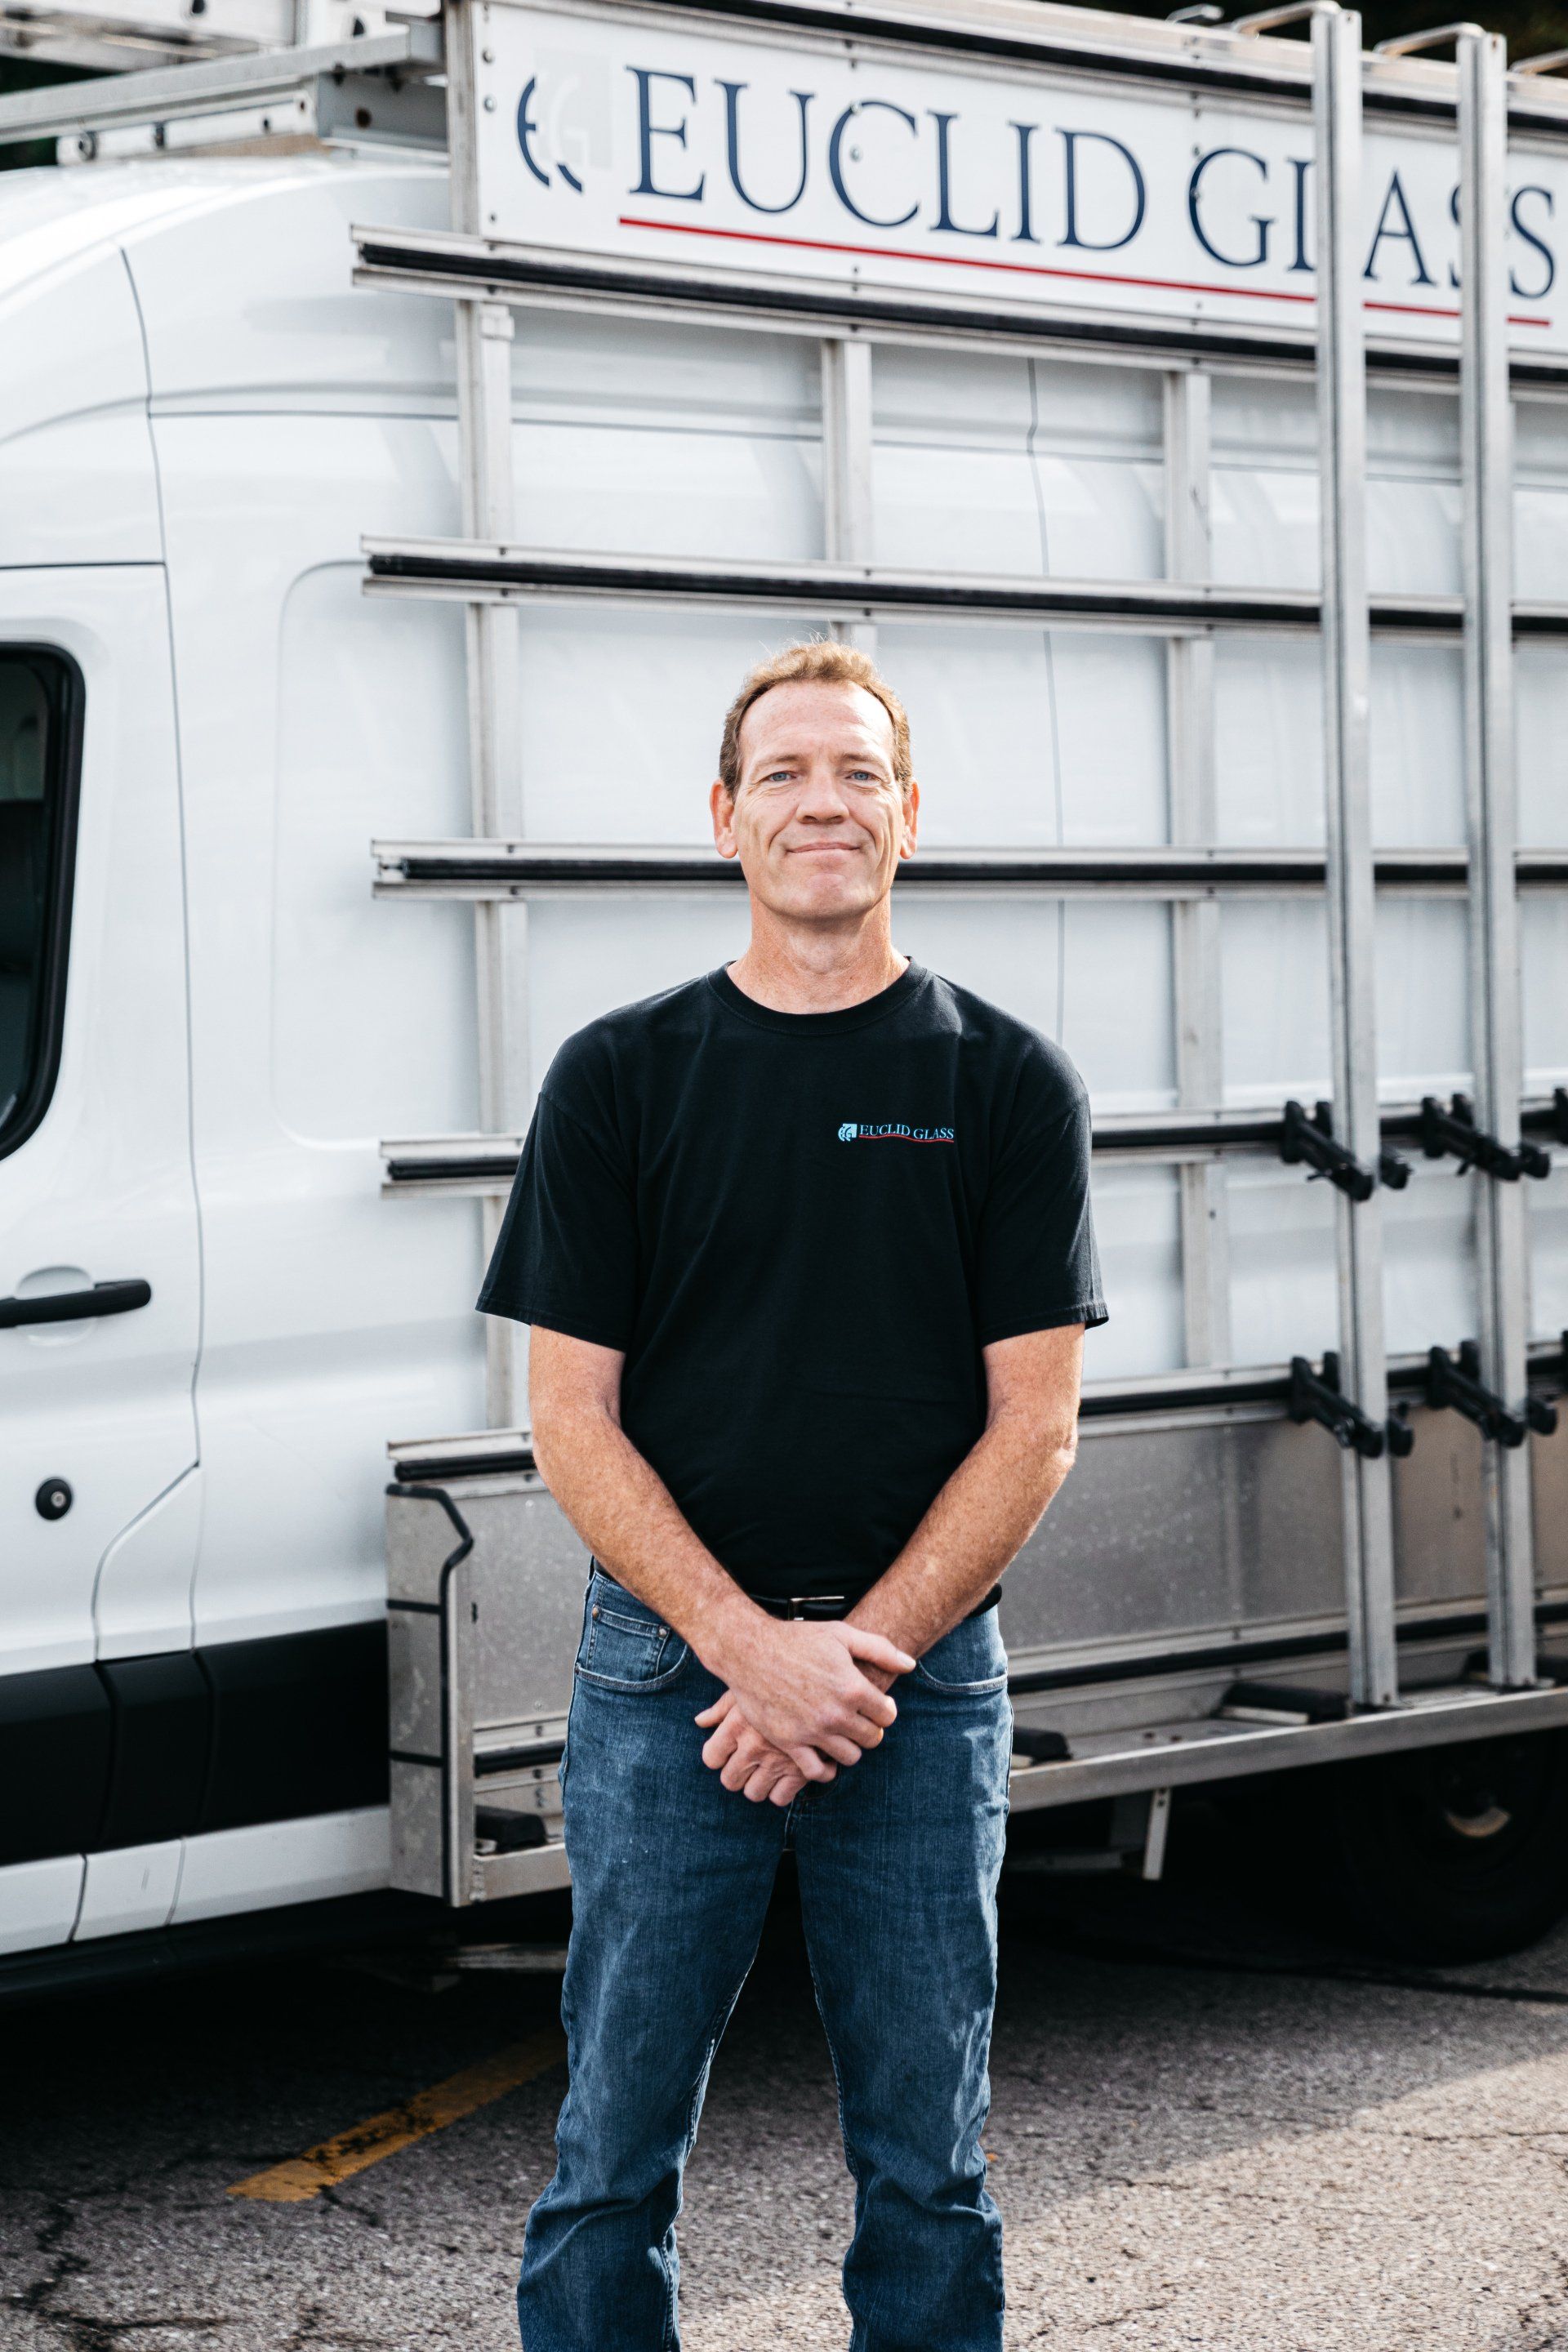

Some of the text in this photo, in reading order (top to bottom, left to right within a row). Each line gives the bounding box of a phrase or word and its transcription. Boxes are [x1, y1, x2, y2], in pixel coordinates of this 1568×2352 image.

[626, 65, 1556, 300] EUCLID GLAS
[859, 1124, 955, 1140] EUCLID GLASS
